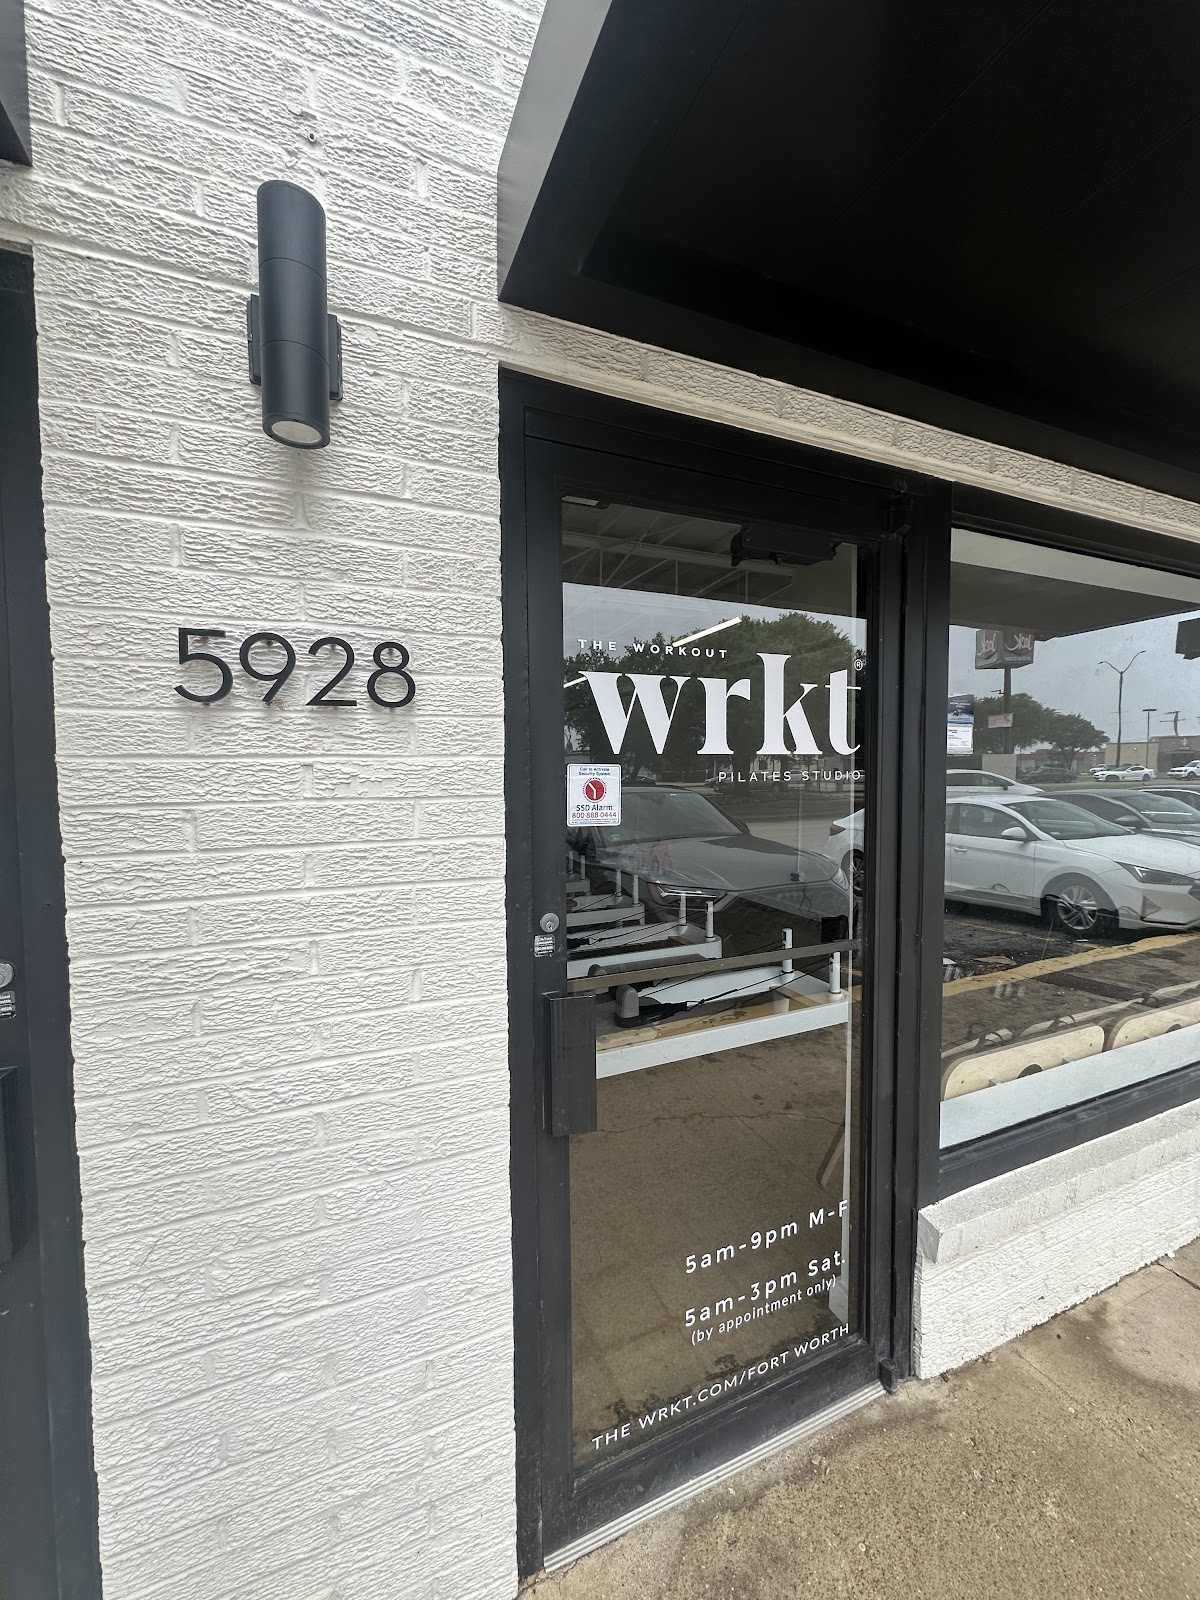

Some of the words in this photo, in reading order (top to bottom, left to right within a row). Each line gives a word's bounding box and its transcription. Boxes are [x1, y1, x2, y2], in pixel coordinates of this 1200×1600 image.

[174, 627, 416, 708] 5928
[577, 638, 617, 651] THE
[633, 642, 728, 659] WORKOUT
[577, 652, 862, 756] wrkt
[591, 803, 613, 811] Alarm
[718, 770, 792, 783] PILATES
[801, 770, 861, 781] STUDIO
[685, 1220, 798, 1274] 5am-9pm
[808, 1199, 849, 1229] M-F
[684, 1270, 798, 1328] 5am-3pm
[807, 1250, 846, 1277] Sat.
[691, 1324, 714, 1346] (by
[717, 1289, 802, 1334] appointment
[806, 1274, 837, 1297] only)
[591, 1423, 631, 1450] THE
[638, 1350, 789, 1429] WRKT.COM/FORT
[793, 1322, 850, 1358] WORTH
